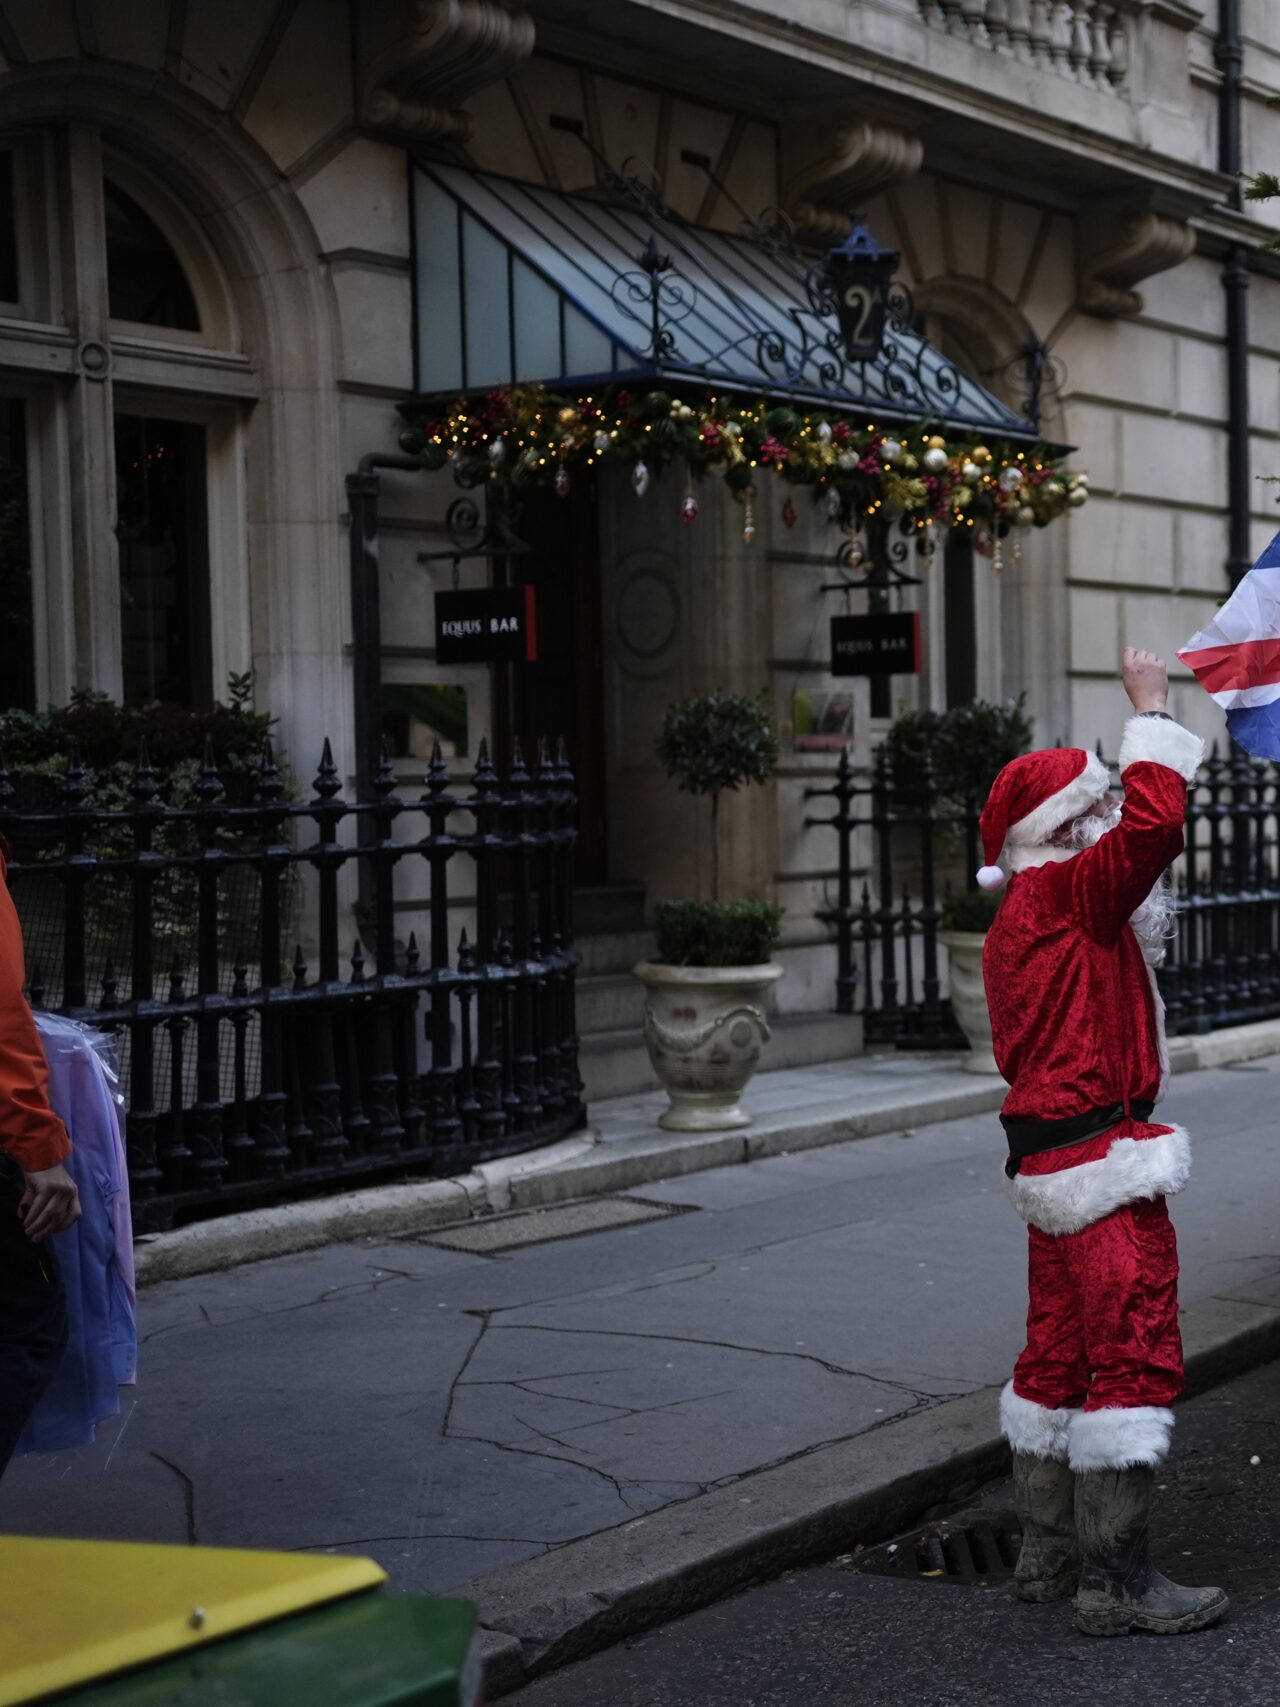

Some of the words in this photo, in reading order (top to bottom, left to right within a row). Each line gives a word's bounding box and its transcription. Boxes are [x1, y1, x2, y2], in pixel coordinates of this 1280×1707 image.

[442, 619, 481, 638] EQUUS
[490, 616, 519, 633] BAR
[881, 637, 907, 652] BAR
